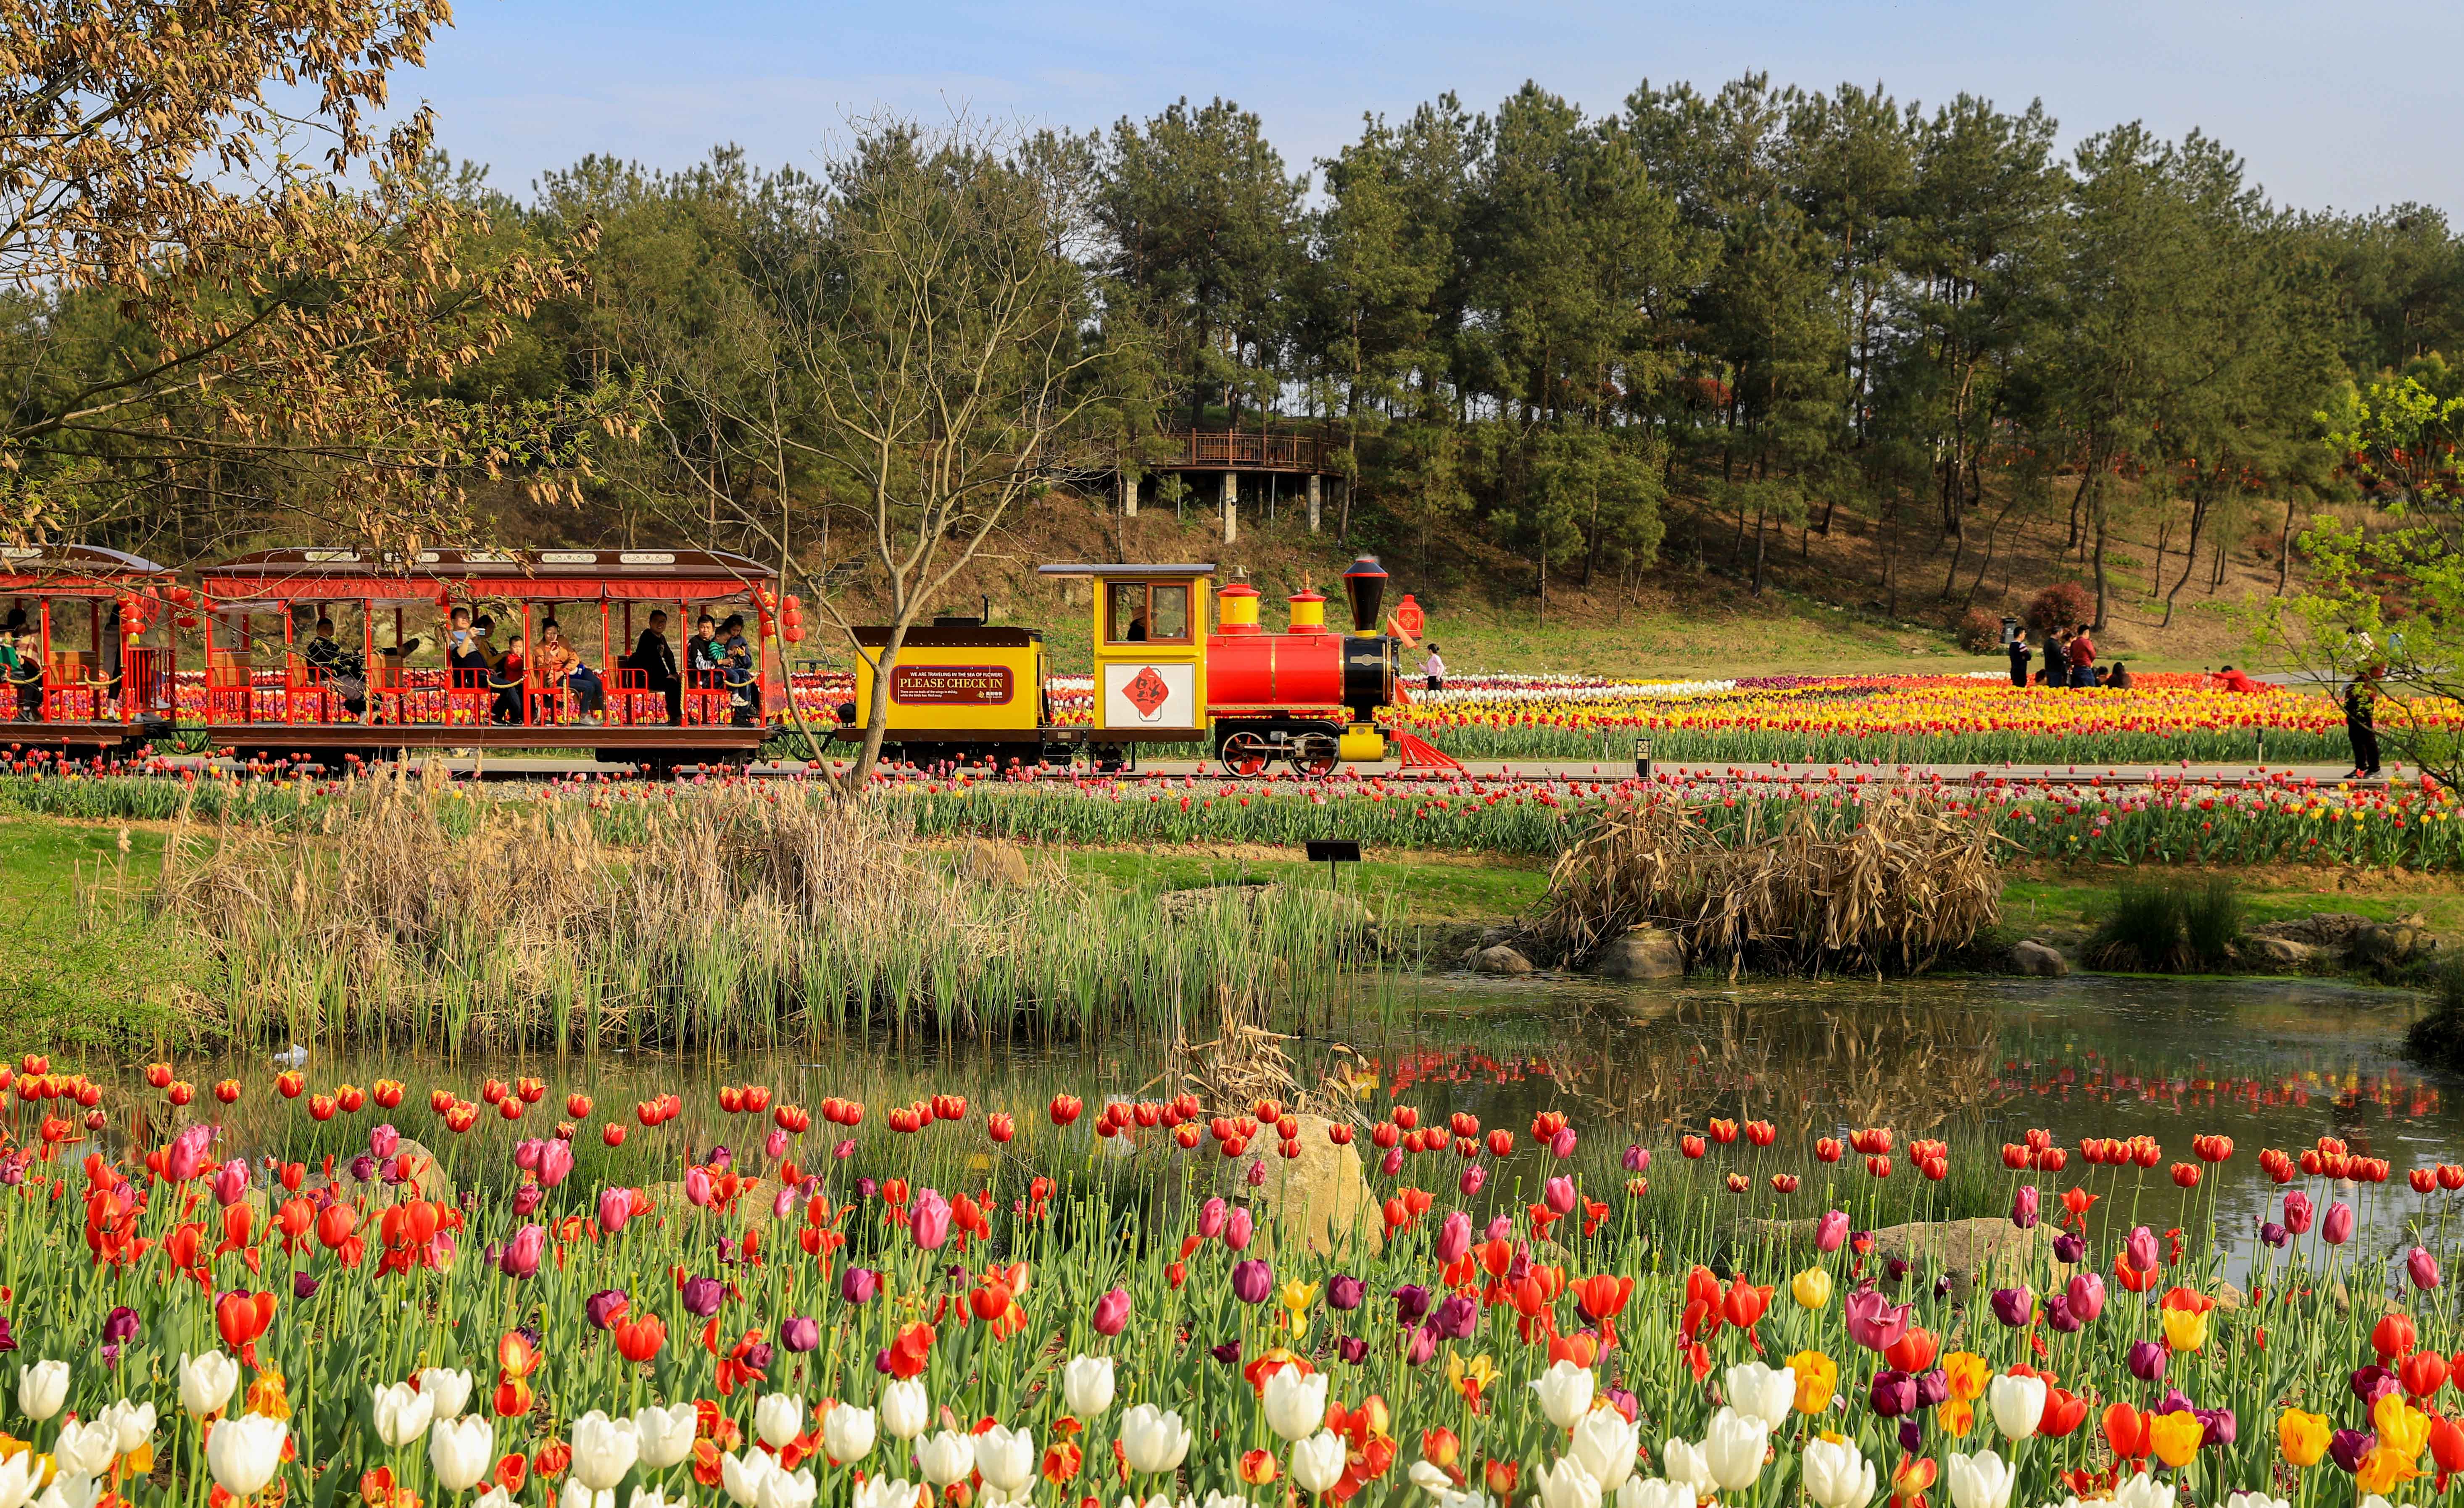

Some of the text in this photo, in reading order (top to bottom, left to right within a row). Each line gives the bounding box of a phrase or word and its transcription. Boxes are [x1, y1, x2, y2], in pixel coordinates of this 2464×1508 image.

[899, 679, 1003, 688] PLEASE CHECK IN
